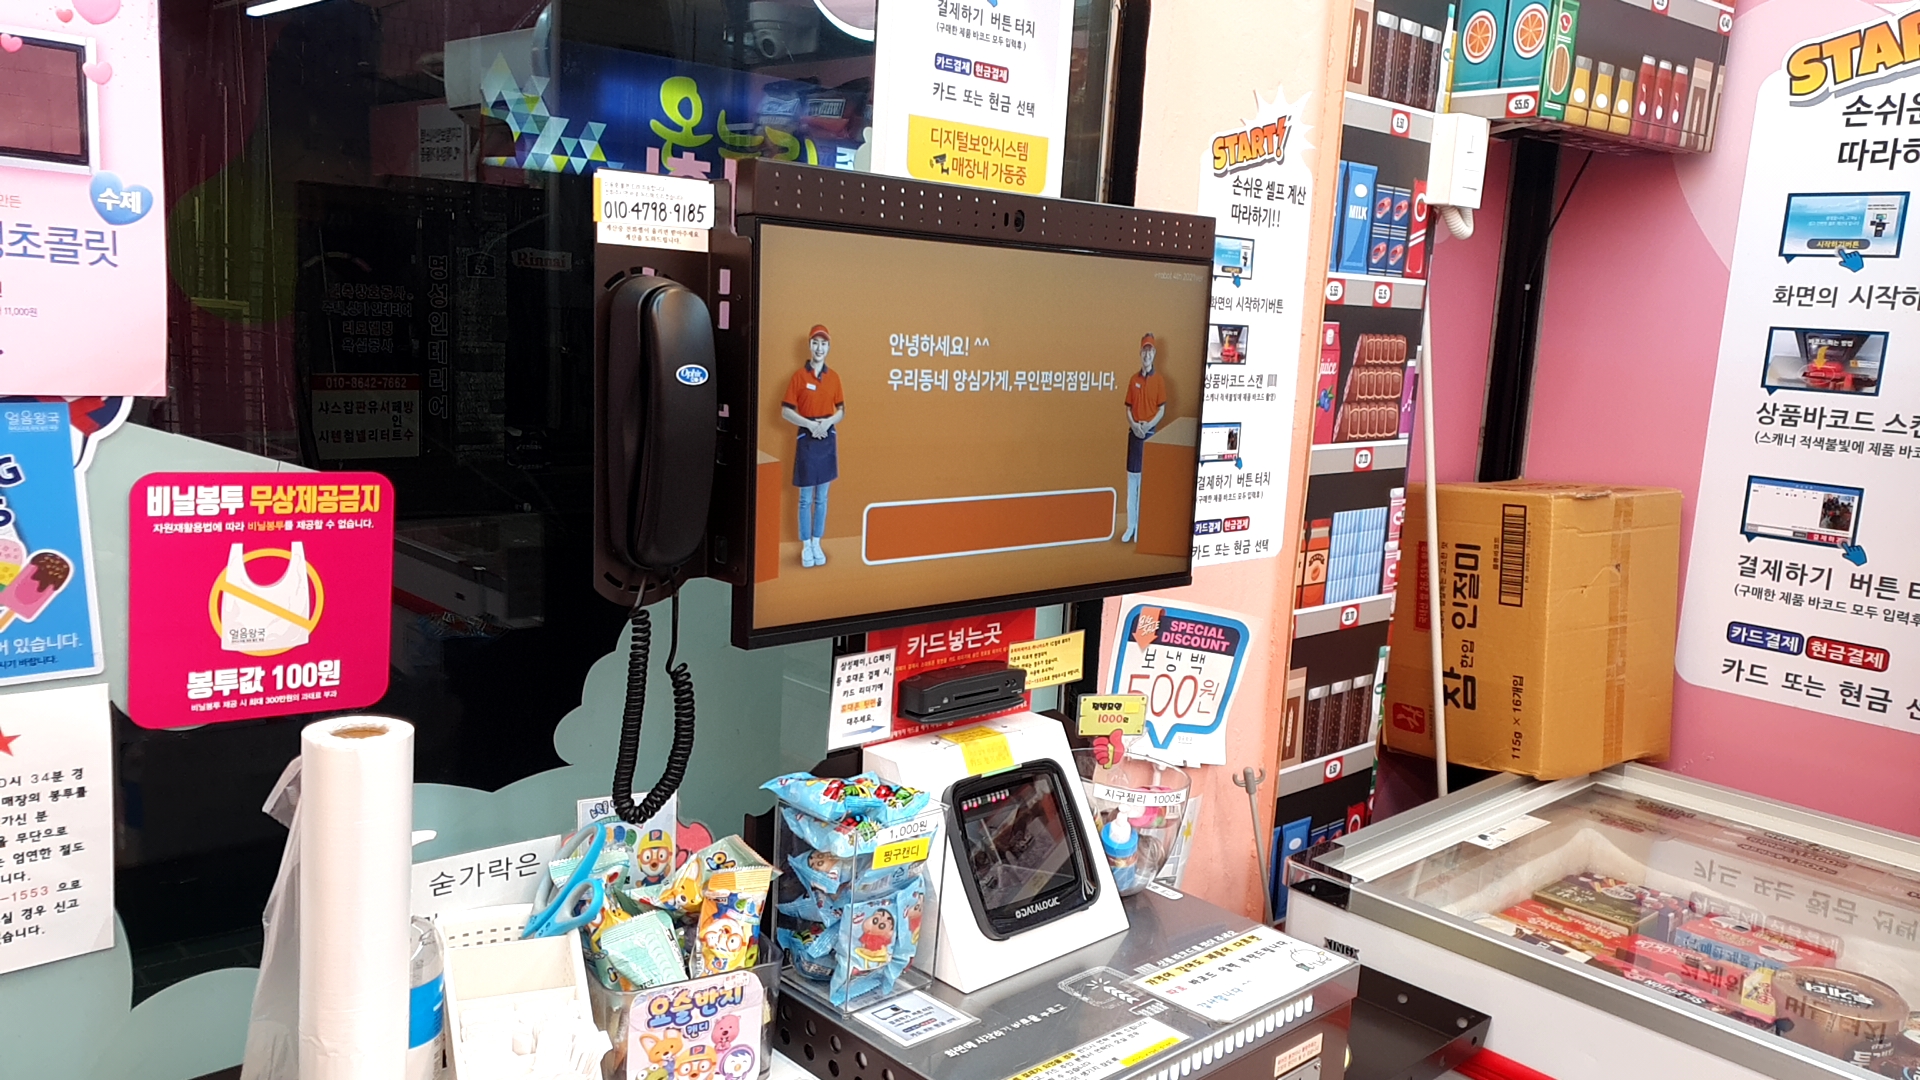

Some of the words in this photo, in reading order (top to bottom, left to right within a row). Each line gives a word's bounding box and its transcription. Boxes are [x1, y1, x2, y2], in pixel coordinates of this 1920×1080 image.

[938, 0, 983, 26] 결제하기
[991, 12, 1012, 32] 버튼
[1015, 18, 1035, 38] 터치
[935, 55, 971, 75] 카드결제
[975, 63, 1008, 82] 현금결제
[933, 82, 957, 101] 카드
[963, 88, 984, 107] 또는
[989, 92, 1011, 113] 현금
[1017, 100, 1035, 118] 선택
[930, 127, 1029, 162] 디지털보안시스템
[1212, 115, 1293, 171] START!
[951, 157, 989, 181] 매장내
[991, 163, 1028, 187] 가동중
[97, 187, 142, 215] 수제
[1231, 174, 1264, 199] 손쉬운
[1265, 179, 1286, 202] 셀프
[1287, 184, 1307, 206] 계산
[1231, 203, 1281, 229] 따라하기!!
[1348, 204, 1368, 221] MILK
[516, 252, 567, 269] Rinnai
[1235, 296, 1284, 314] 시작하기버튼
[1772, 284, 1839, 309] 화면의
[889, 332, 970, 357] 안녕하세요!
[886, 368, 949, 392] 우리동네
[1204, 373, 1246, 389] 상품바코드
[1247, 373, 1264, 389] 스캔
[1318, 356, 1338, 382] juice
[325, 376, 408, 389] 010-8642-7662
[4, 409, 60, 426] 얼음왕국
[1756, 402, 1876, 433] 상품바코드
[1754, 430, 1796, 448] (스캐너
[1799, 434, 1866, 455] 적색불빛에
[1867, 441, 1896, 458] 제품
[1196, 473, 1232, 491] 결제하기
[1236, 471, 1254, 488] 버튼
[1254, 470, 1271, 487] 터치
[146, 485, 245, 517] 비닐봉투
[249, 484, 381, 515] 무상제공금지
[225, 521, 245, 532] 따라
[296, 519, 324, 531] 제공할
[326, 519, 335, 530] 수
[337, 518, 375, 530] 없습니다.
[1194, 520, 1221, 534] 카드결제
[1223, 518, 1249, 531] 현금결제
[1192, 543, 1211, 560] 카드
[1214, 541, 1231, 557] 또는
[1233, 539, 1251, 556] 현금
[1254, 538, 1270, 553] 선택
[1451, 543, 1481, 629] 인절미
[1737, 554, 1834, 591] 결제하기
[1849, 572, 1901, 602] 버튼
[1734, 583, 1776, 603] (구매한
[1779, 591, 1805, 608] 제품
[1807, 595, 1848, 614] 바코드
[1850, 603, 1879, 620] 모두
[906, 622, 1003, 658] 카드넣는곳
[1161, 631, 1230, 652] DISCOUNT
[1170, 620, 1226, 640] SPECIAL
[1730, 625, 1800, 653] 카드결제
[13, 631, 84, 655] 있습니다.
[1460, 640, 1475, 668] 한입
[1810, 640, 1885, 670] 현금결제
[186, 665, 266, 700] 봉투값
[271, 659, 341, 691] 100원
[1721, 657, 1770, 686] 카드
[1781, 671, 1827, 699] 또는
[1839, 679, 1894, 714] 현금
[842, 688, 855, 698] 카드
[1511, 675, 1524, 714] 16개입
[846, 714, 875, 726] 대주세요.
[1511, 731, 1524, 760] 115g
[30, 770, 65, 785] 34분
[71, 767, 84, 781] 경
[1105, 789, 1147, 805] 지구젤리
[1153, 792, 1182, 805] 1000원
[35, 810, 48, 824] 분
[16, 826, 69, 844] 무단으로
[889, 819, 928, 840] 1,000원
[13, 847, 53, 865] 엄연한
[59, 842, 86, 857] 절도
[56, 879, 82, 893] 으로
[428, 852, 542, 897] 숟가락은
[21, 905, 48, 921] 경우
[54, 898, 81, 915] 신고
[1020, 897, 1061, 919] DATALOGIC
[685, 1019, 710, 1038] 캔디
